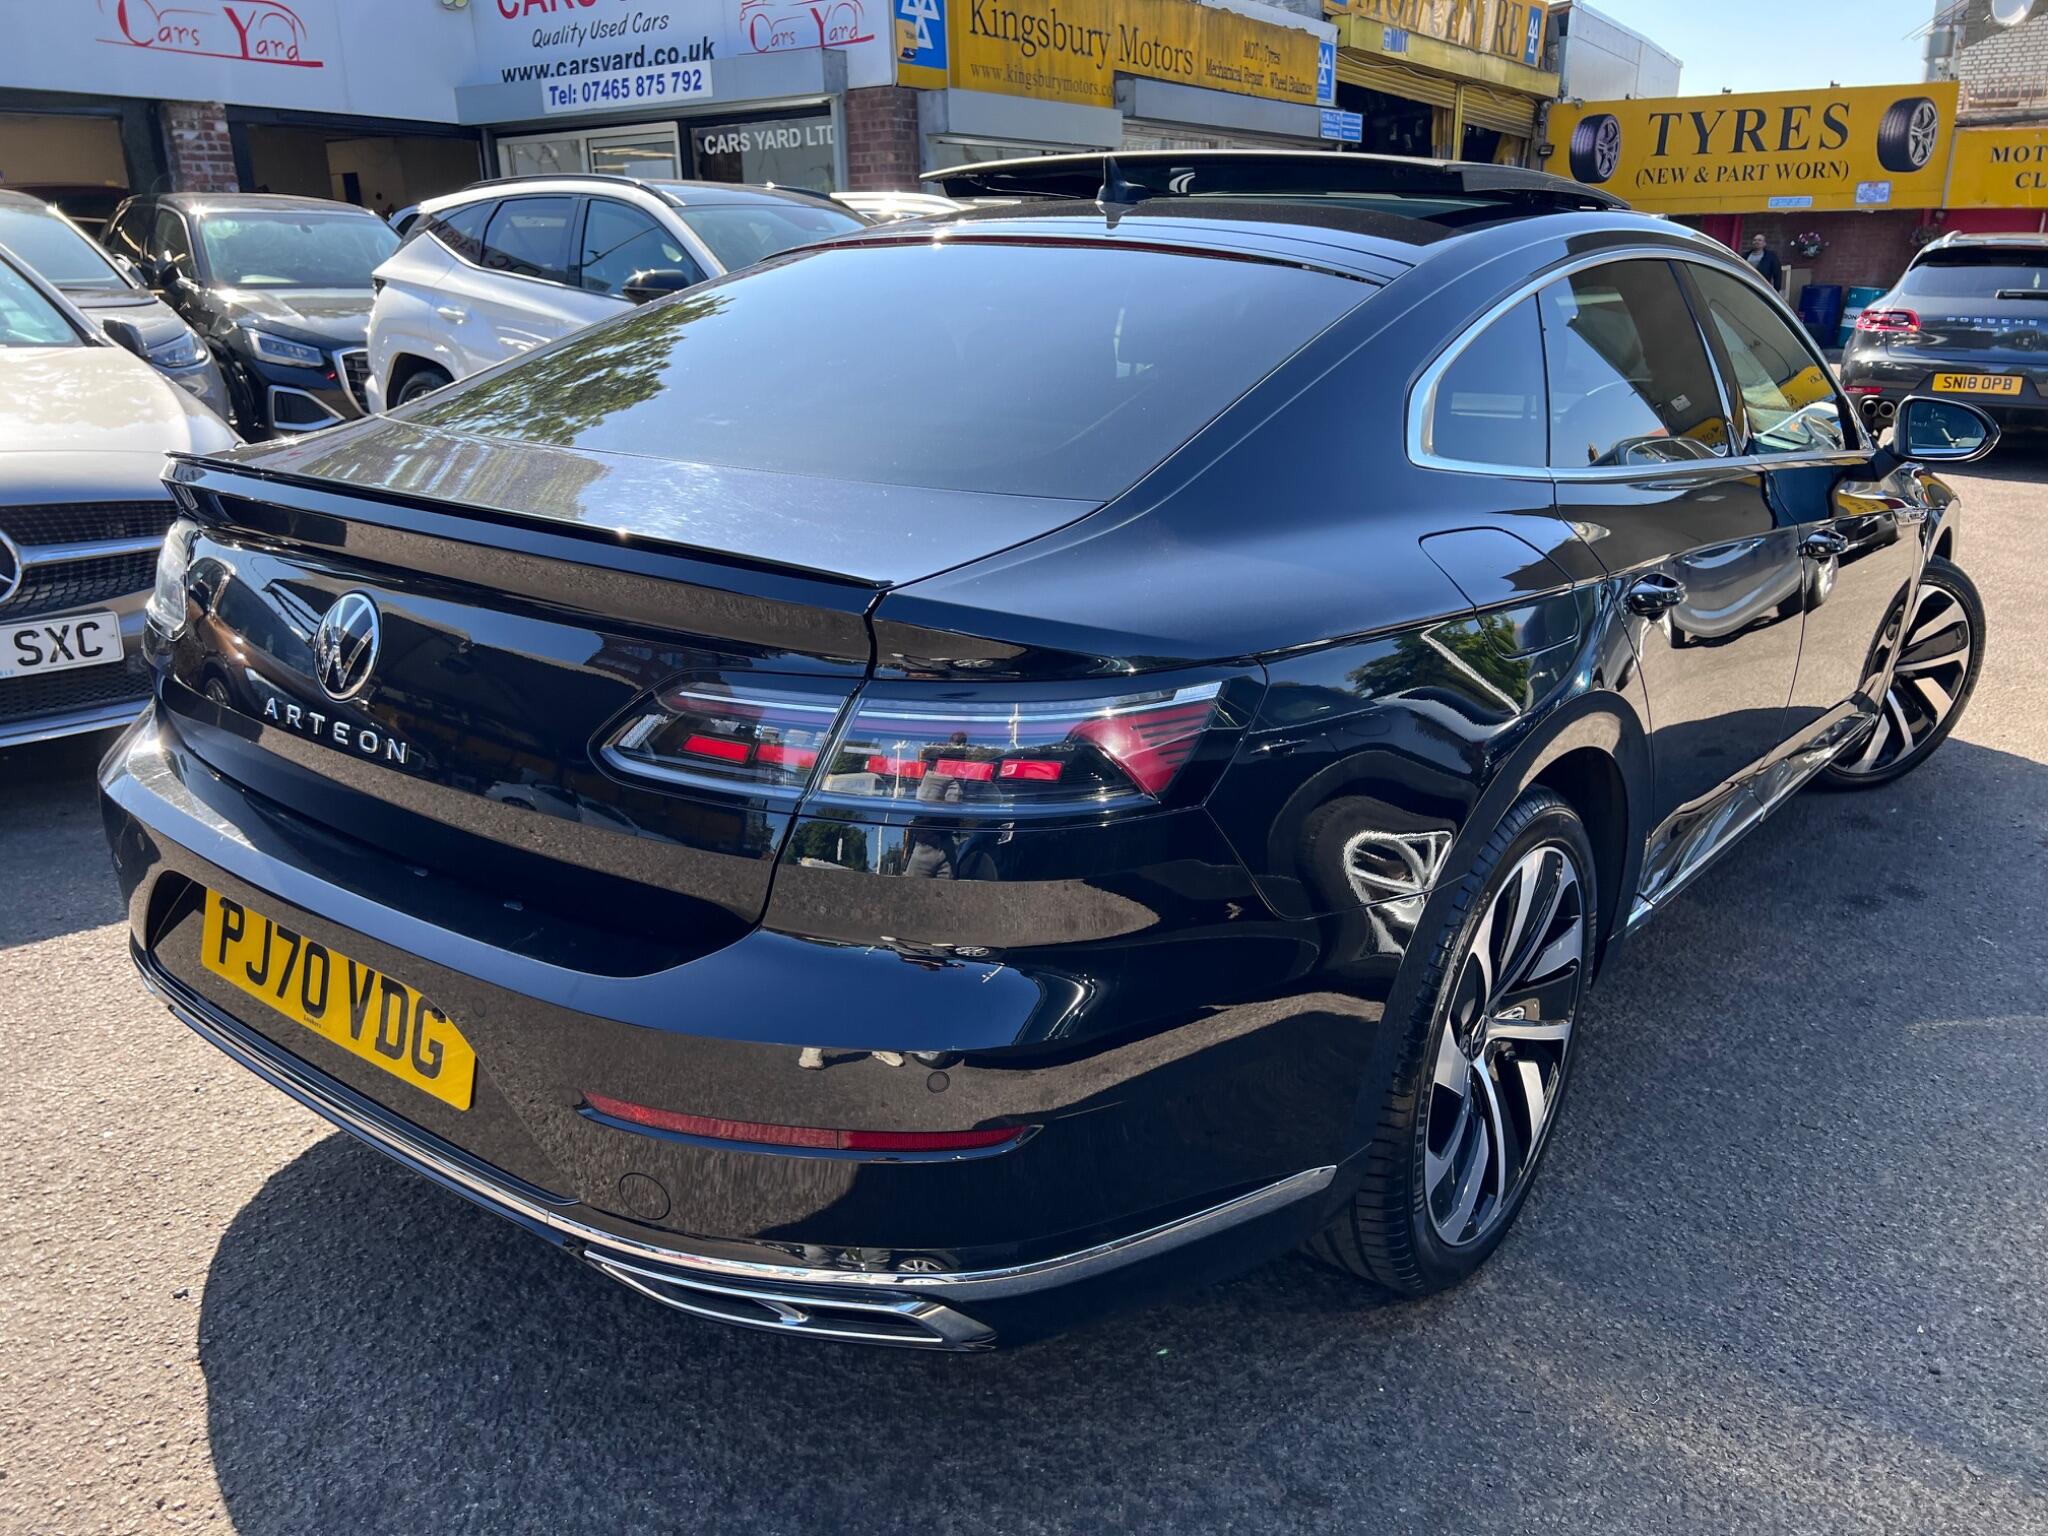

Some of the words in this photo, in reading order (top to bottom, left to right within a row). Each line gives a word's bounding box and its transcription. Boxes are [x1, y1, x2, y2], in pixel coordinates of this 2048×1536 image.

[497, 0, 597, 20] CA
[532, 22, 587, 48] Quality
[590, 13, 629, 39] Used
[632, 12, 670, 34] Cars
[750, 13, 796, 53] Cars
[810, 5, 860, 48] Yard
[116, 0, 200, 47] Cars
[223, 6, 300, 62] Yard
[969, 0, 1111, 70] Kingsbury
[1118, 23, 1194, 76] Motors
[549, 84, 577, 106] Tel:
[582, 77, 630, 101] 07465
[636, 73, 665, 97] 875
[671, 69, 703, 93] 792
[704, 131, 751, 155] CARS
[754, 128, 801, 150] YARD
[1648, 102, 1851, 157] TYRES
[1635, 166, 1689, 190] (NEW
[1693, 166, 1709, 183] &
[1716, 164, 1770, 183] PART
[1776, 160, 1849, 180] WORN)
[1946, 316, 2039, 326] PORSCHE
[1943, 376, 1977, 389] SN18
[1981, 377, 2012, 390] OPB
[13, 621, 104, 667] SXC
[263, 696, 410, 764] ARTEON
[218, 896, 330, 1020] PJ70
[347, 957, 445, 1080] VDG
